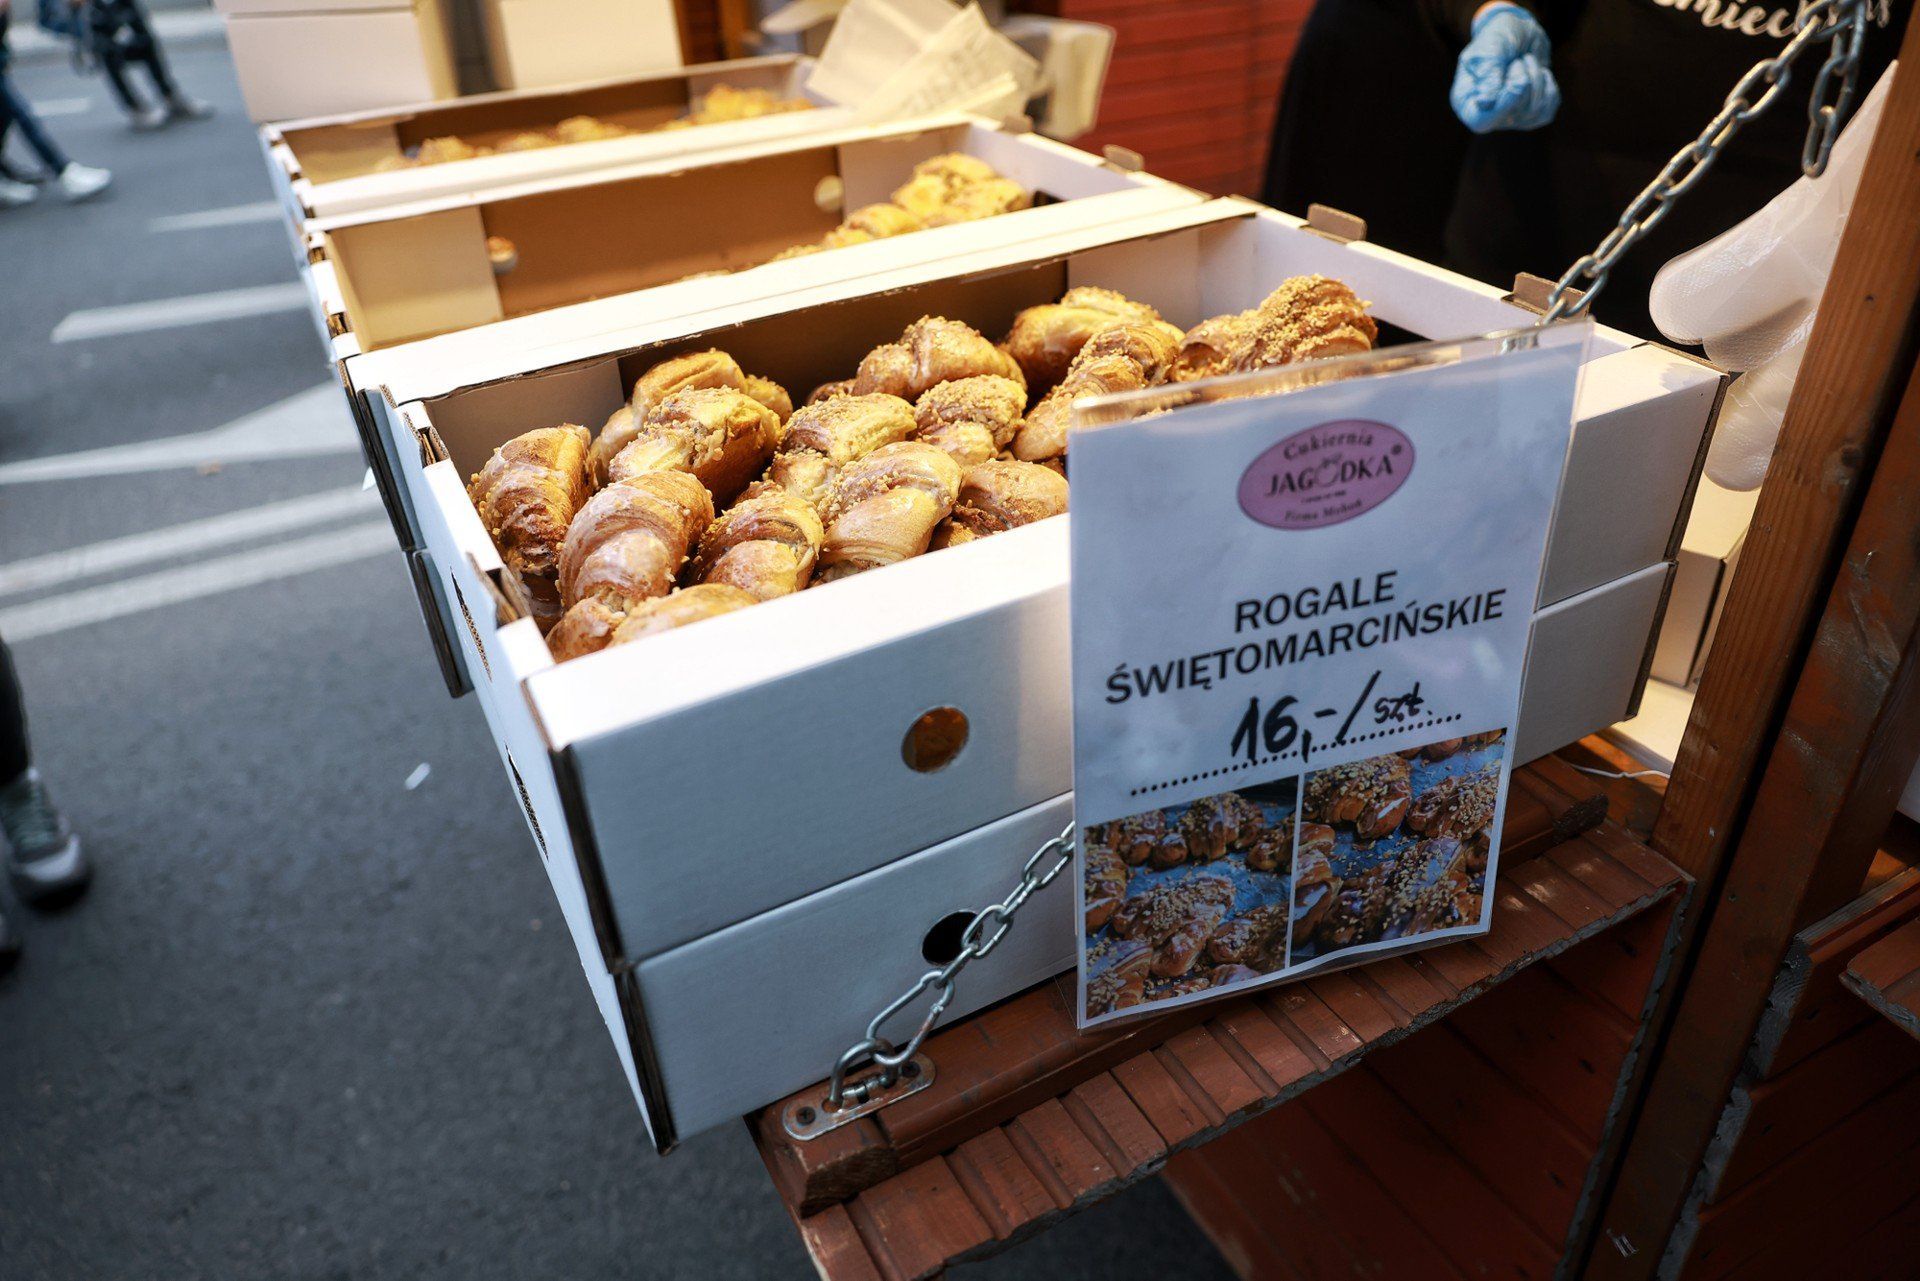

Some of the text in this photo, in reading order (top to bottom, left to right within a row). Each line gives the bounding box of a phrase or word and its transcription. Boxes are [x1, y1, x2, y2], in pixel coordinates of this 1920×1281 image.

[1283, 428, 1374, 460] Cukiernia
[1234, 570, 1397, 633] ROGALE
[1105, 589, 1507, 704] ŚWIĘTOMARCIŃSKIE
